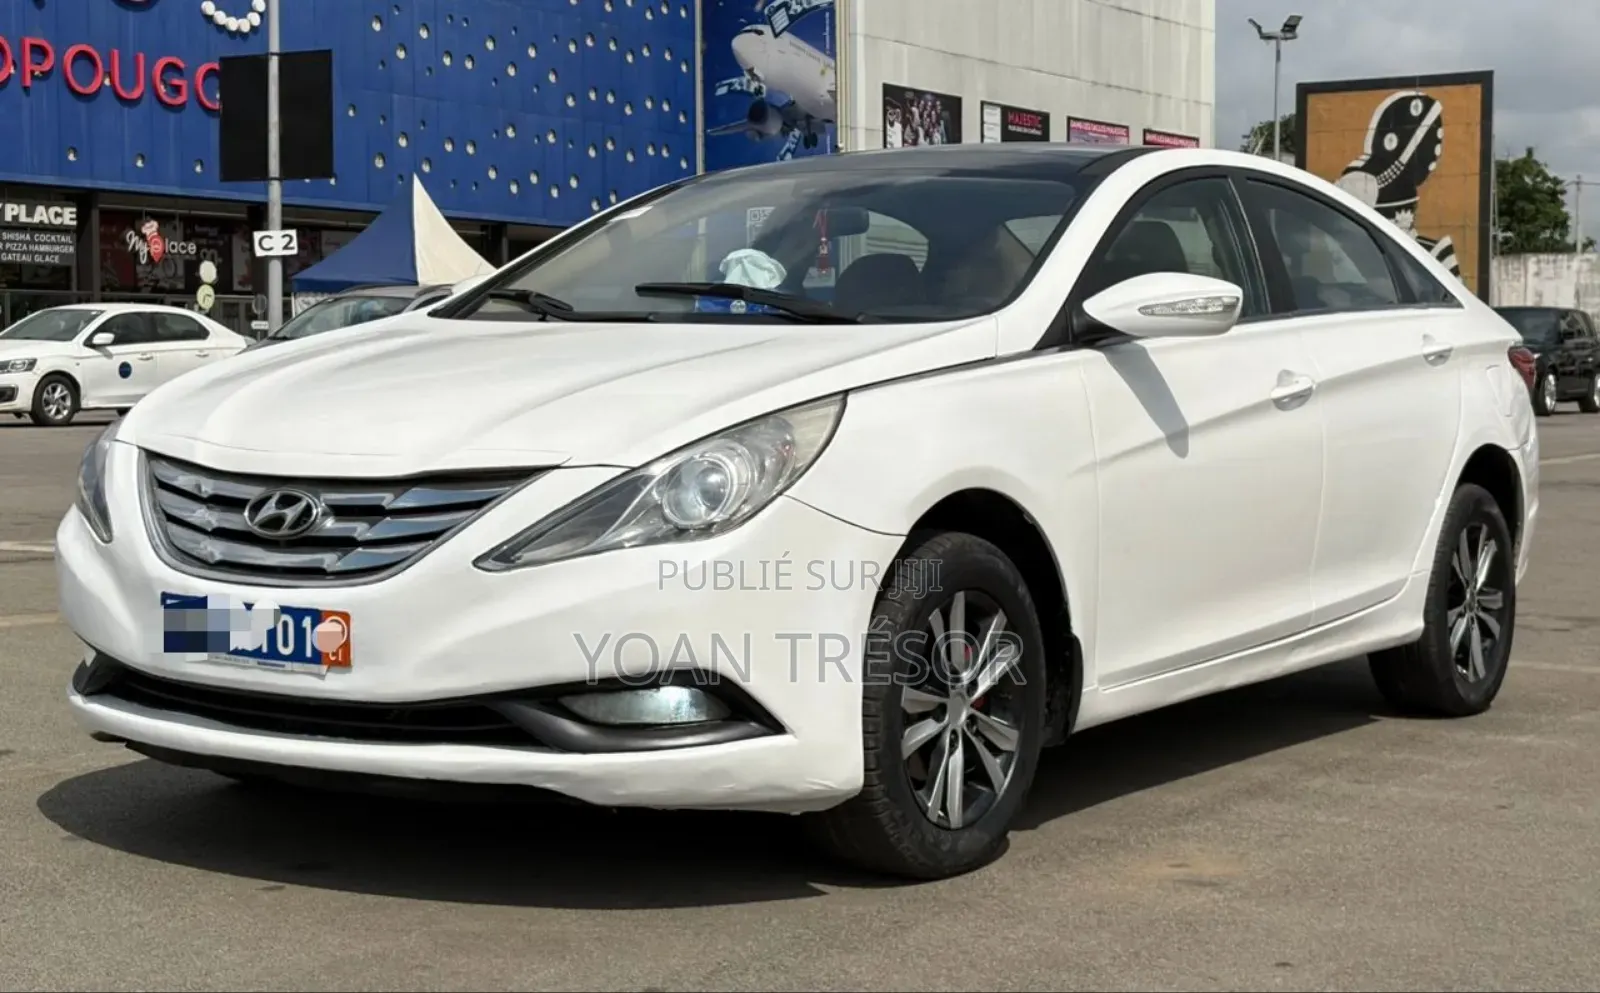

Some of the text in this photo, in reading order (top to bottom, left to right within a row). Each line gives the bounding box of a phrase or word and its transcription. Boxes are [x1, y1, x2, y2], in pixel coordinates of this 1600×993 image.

[4, 203, 77, 226] PLACE
[34, 233, 73, 244] COCKTAIL
[5, 242, 27, 252] PIZZA
[29, 244, 74, 253] HAMBURGER
[1, 252, 60, 264] GATEAU GLACE
